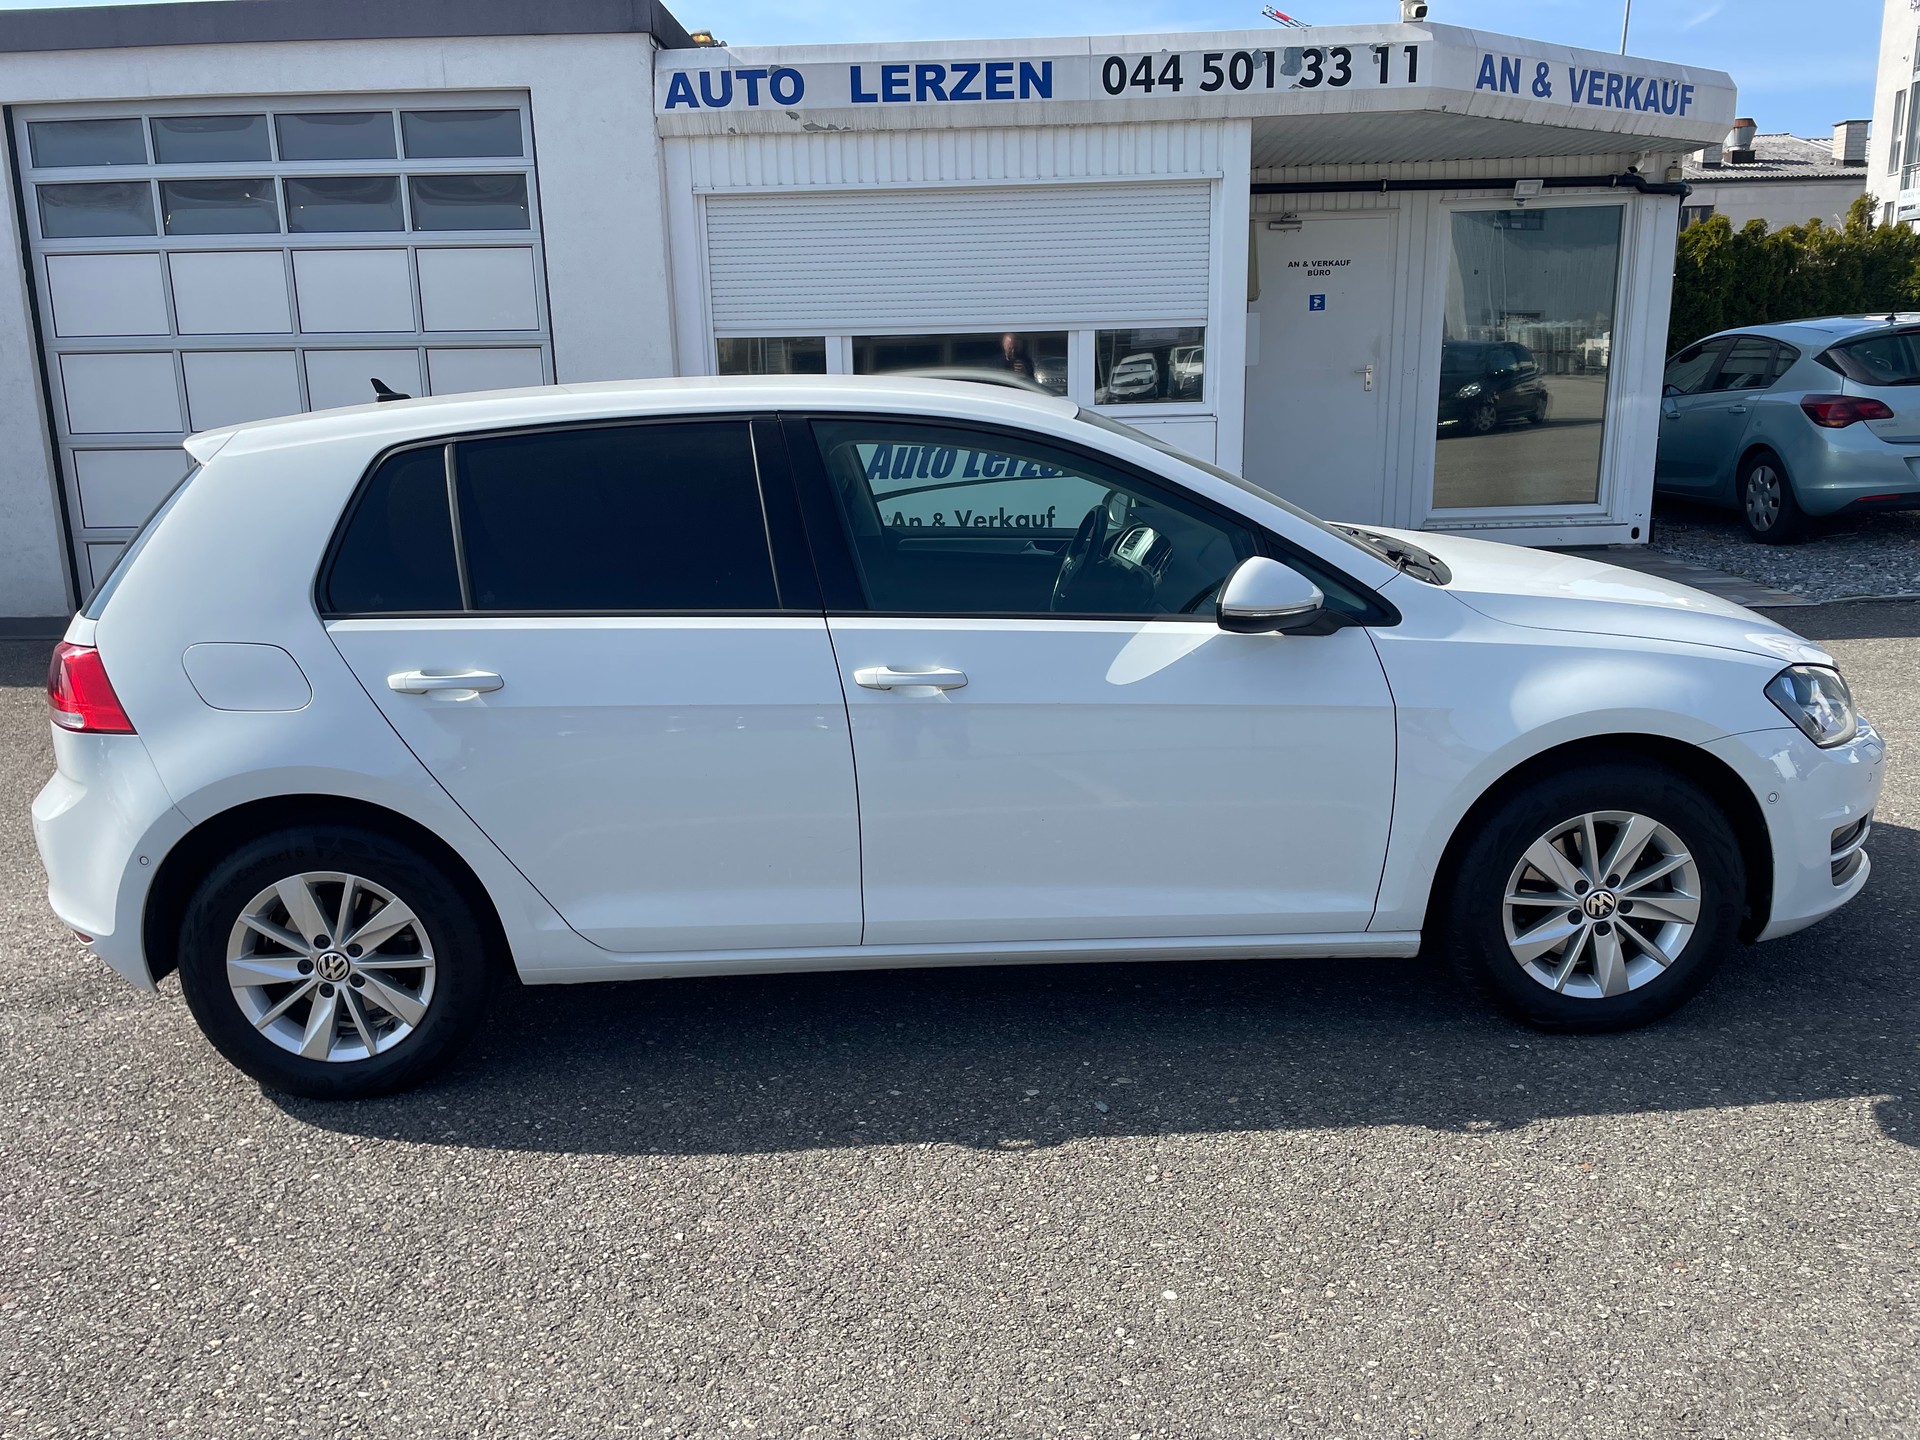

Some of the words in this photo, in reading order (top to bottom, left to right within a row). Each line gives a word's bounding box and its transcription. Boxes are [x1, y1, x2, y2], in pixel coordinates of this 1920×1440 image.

[664, 68, 805, 109] AUTO
[850, 61, 1053, 103] LERZEN
[1102, 54, 1184, 95] 044
[1199, 51, 1275, 92] 501
[1299, 46, 1353, 88] 33
[1373, 45, 1418, 84] 11
[1476, 53, 1521, 94] AN
[1532, 62, 1552, 98] &
[1568, 67, 1695, 116] VERKAUF
[1311, 259, 1352, 267] VERKAUF
[866, 444, 958, 480] Auto
[891, 511, 922, 527] An
[932, 512, 946, 527] &
[954, 505, 1056, 528] Verkauf
